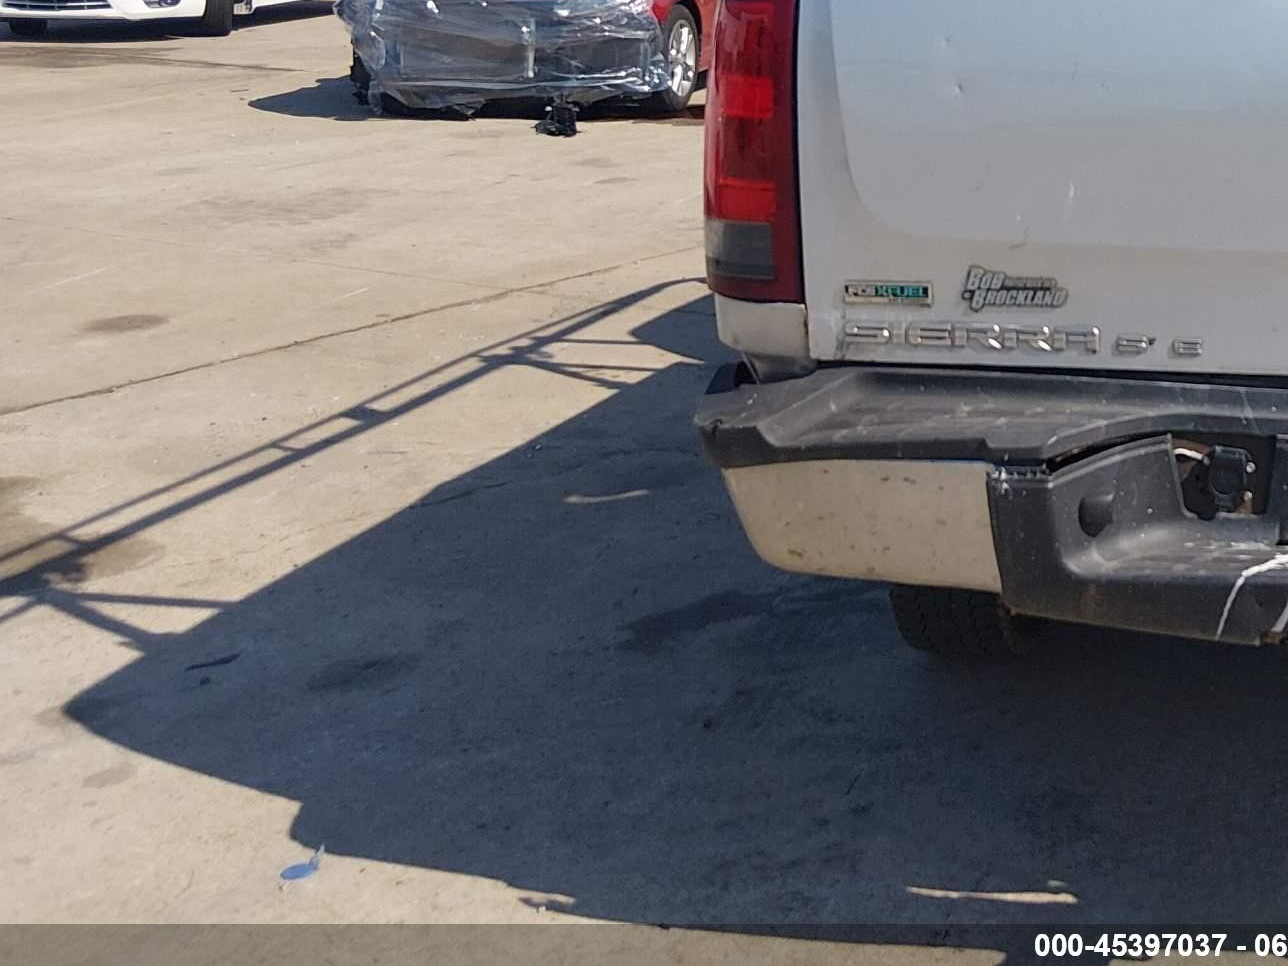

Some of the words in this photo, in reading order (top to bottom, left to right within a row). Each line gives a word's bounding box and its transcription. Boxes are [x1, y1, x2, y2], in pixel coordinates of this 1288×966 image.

[966, 266, 1006, 290] BOB
[970, 290, 1068, 312] BROCKLAND
[845, 321, 1099, 354] SIERRA
